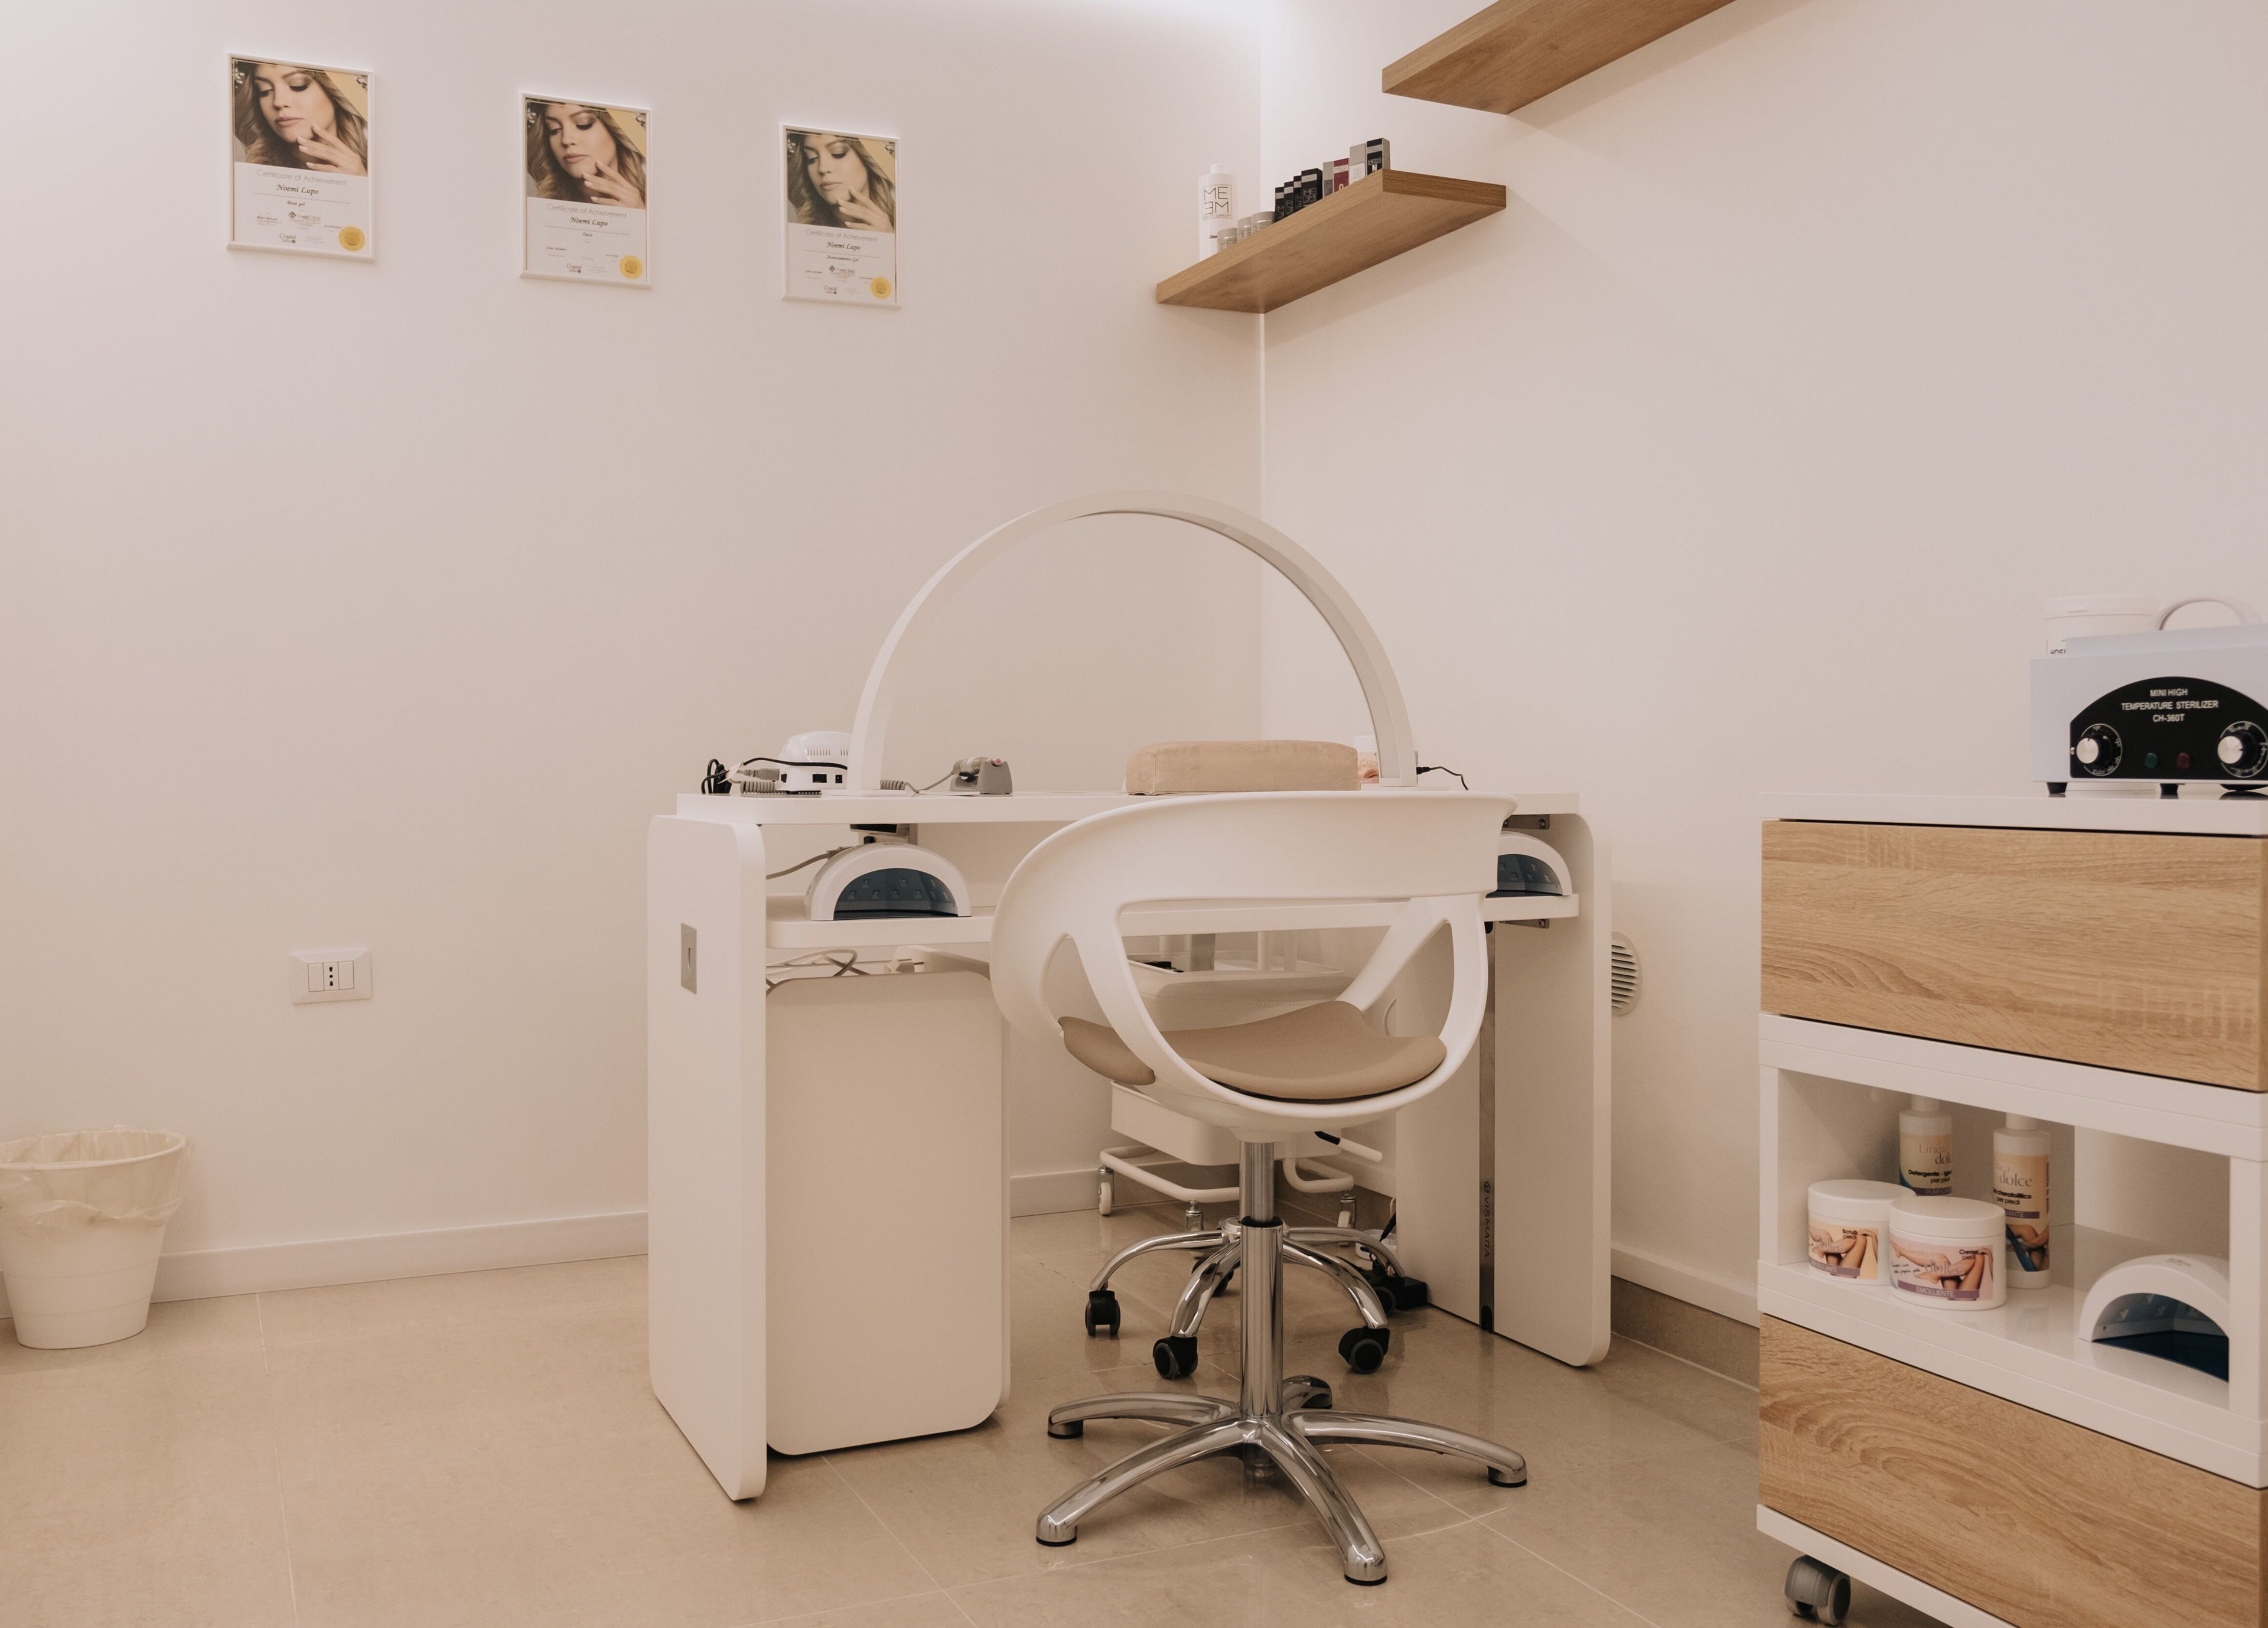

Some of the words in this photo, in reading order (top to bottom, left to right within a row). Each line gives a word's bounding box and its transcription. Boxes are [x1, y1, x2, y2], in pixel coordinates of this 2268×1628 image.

[256, 169, 292, 180] Certificate
[303, 175, 347, 185] Achievement
[276, 184, 299, 193] Noemi
[301, 187, 319, 196] Lupo
[546, 203, 579, 213] Certificate
[589, 208, 627, 219] Achievement
[592, 219, 608, 227] Lupo
[846, 243, 861, 252] Lupo
[2168, 688, 2188, 696] HIGH
[2122, 701, 2174, 711] TEMPERATURE
[2176, 700, 2219, 709] STERILIZER
[1999, 1171, 2033, 1187] dolce
[1915, 1286, 1955, 1297] EMOLLIENTE
